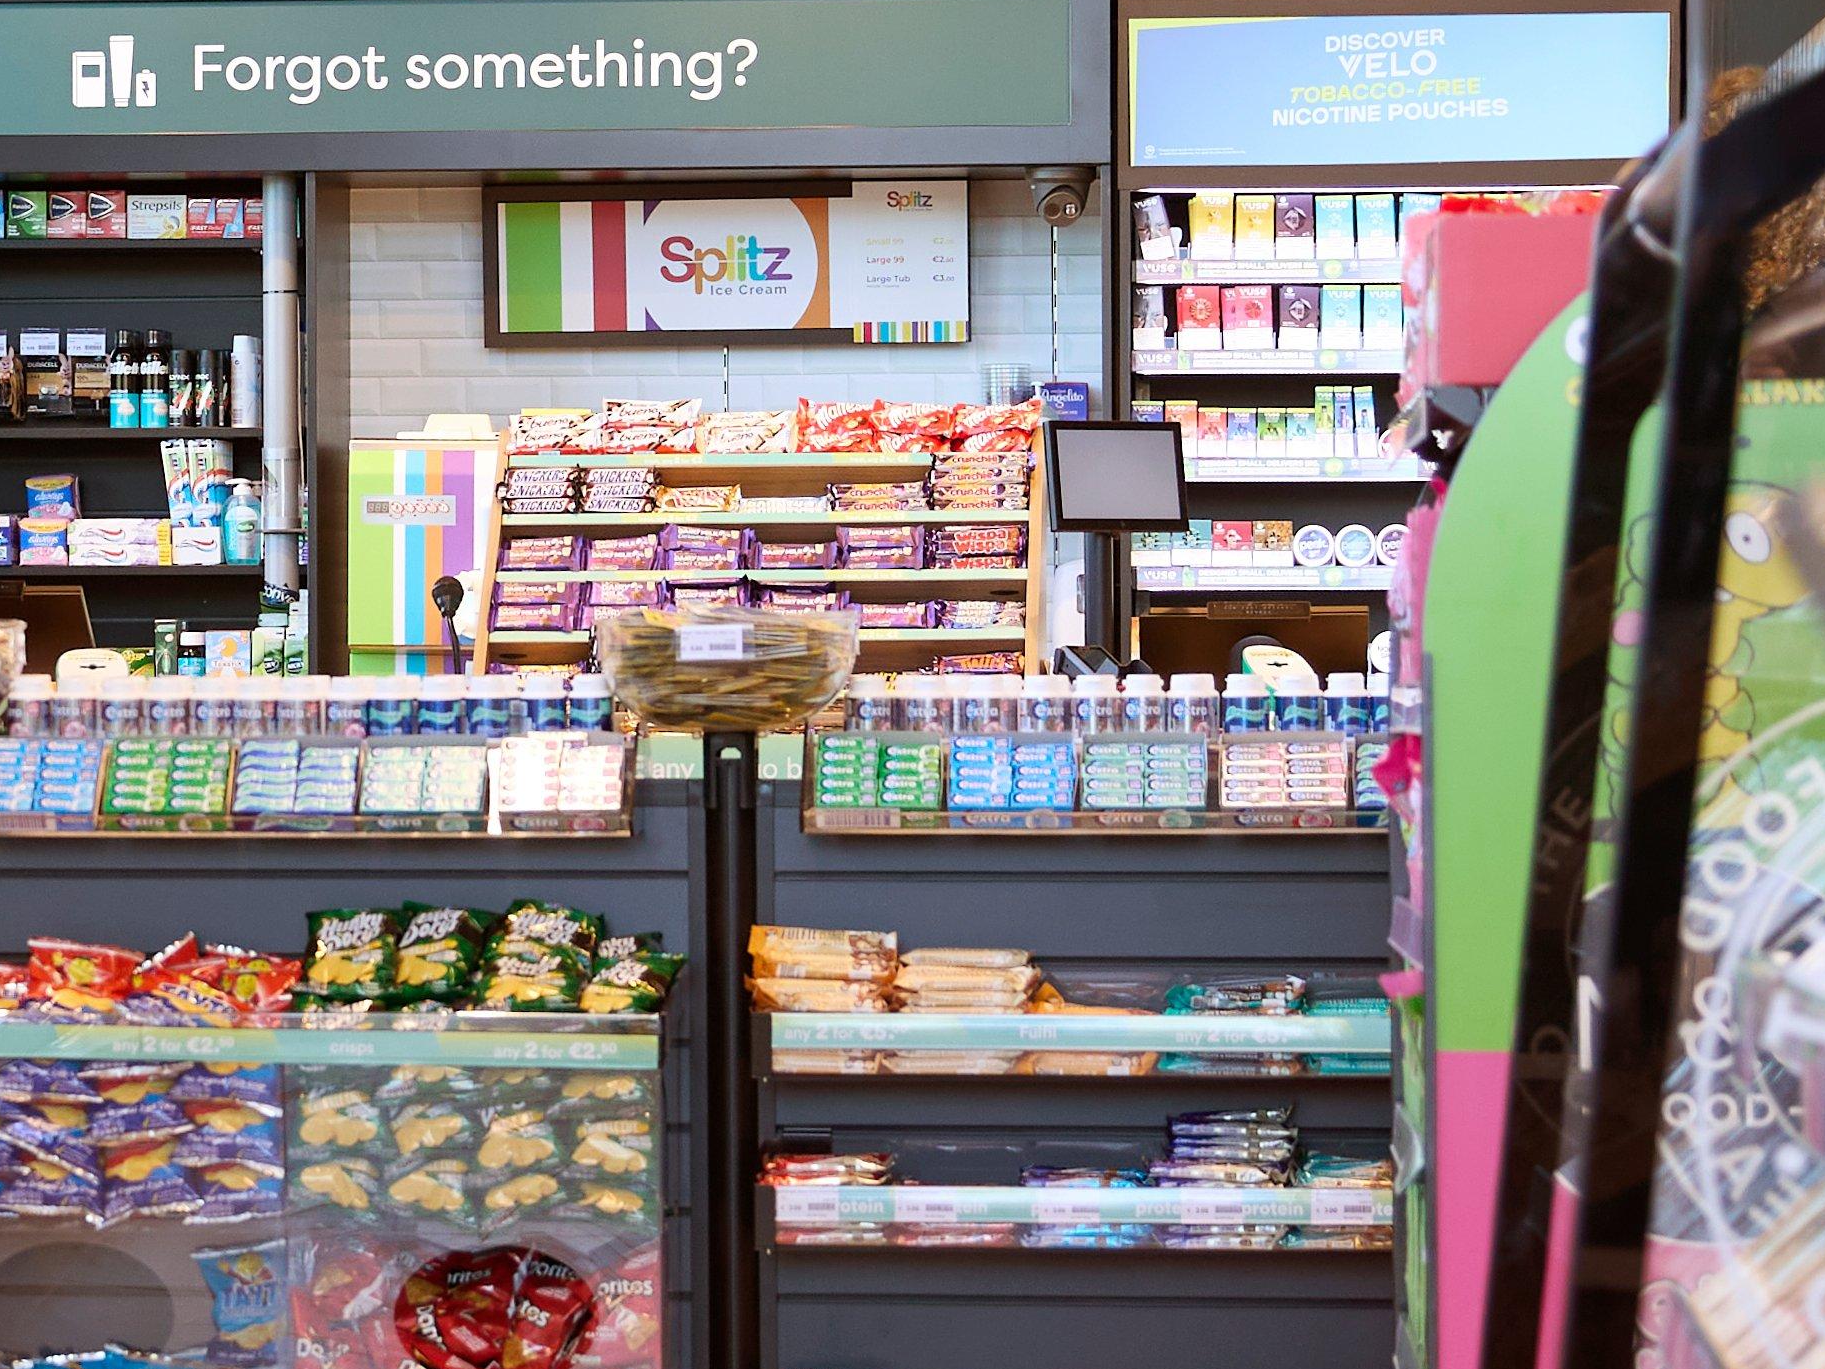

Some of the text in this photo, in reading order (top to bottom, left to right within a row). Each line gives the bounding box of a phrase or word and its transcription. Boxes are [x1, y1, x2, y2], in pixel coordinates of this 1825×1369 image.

[1325, 28, 1445, 53] DISCOVER
[195, 39, 758, 104] Forgot something?
[1337, 50, 1437, 79] VELO
[1272, 98, 1509, 127] NICOTINE POUCHES
[132, 200, 182, 213] Strepsils
[887, 191, 933, 211] Splitz
[660, 235, 793, 295] Splitz
[867, 256, 891, 265] Large
[867, 275, 891, 283] Large
[710, 285, 787, 295] Ice Cream
[1040, 389, 1084, 409] Angelito
[514, 470, 566, 482] SNICKERS
[589, 469, 643, 482] SNICKERS
[587, 498, 641, 512] SNICKERS
[784, 1025, 810, 1042] any
[816, 1025, 828, 1039] 2
[1175, 1031, 1202, 1045] any
[1207, 1029, 1220, 1042] 2
[113, 1040, 139, 1054] any
[143, 1037, 157, 1052] 2
[160, 1039, 182, 1052] for
[329, 1041, 374, 1056] crisps
[493, 1045, 520, 1060] any
[524, 1041, 539, 1057] 2
[541, 1045, 562, 1059] for
[840, 1200, 885, 1214] otein
[1135, 1202, 1304, 1218] prote protein
